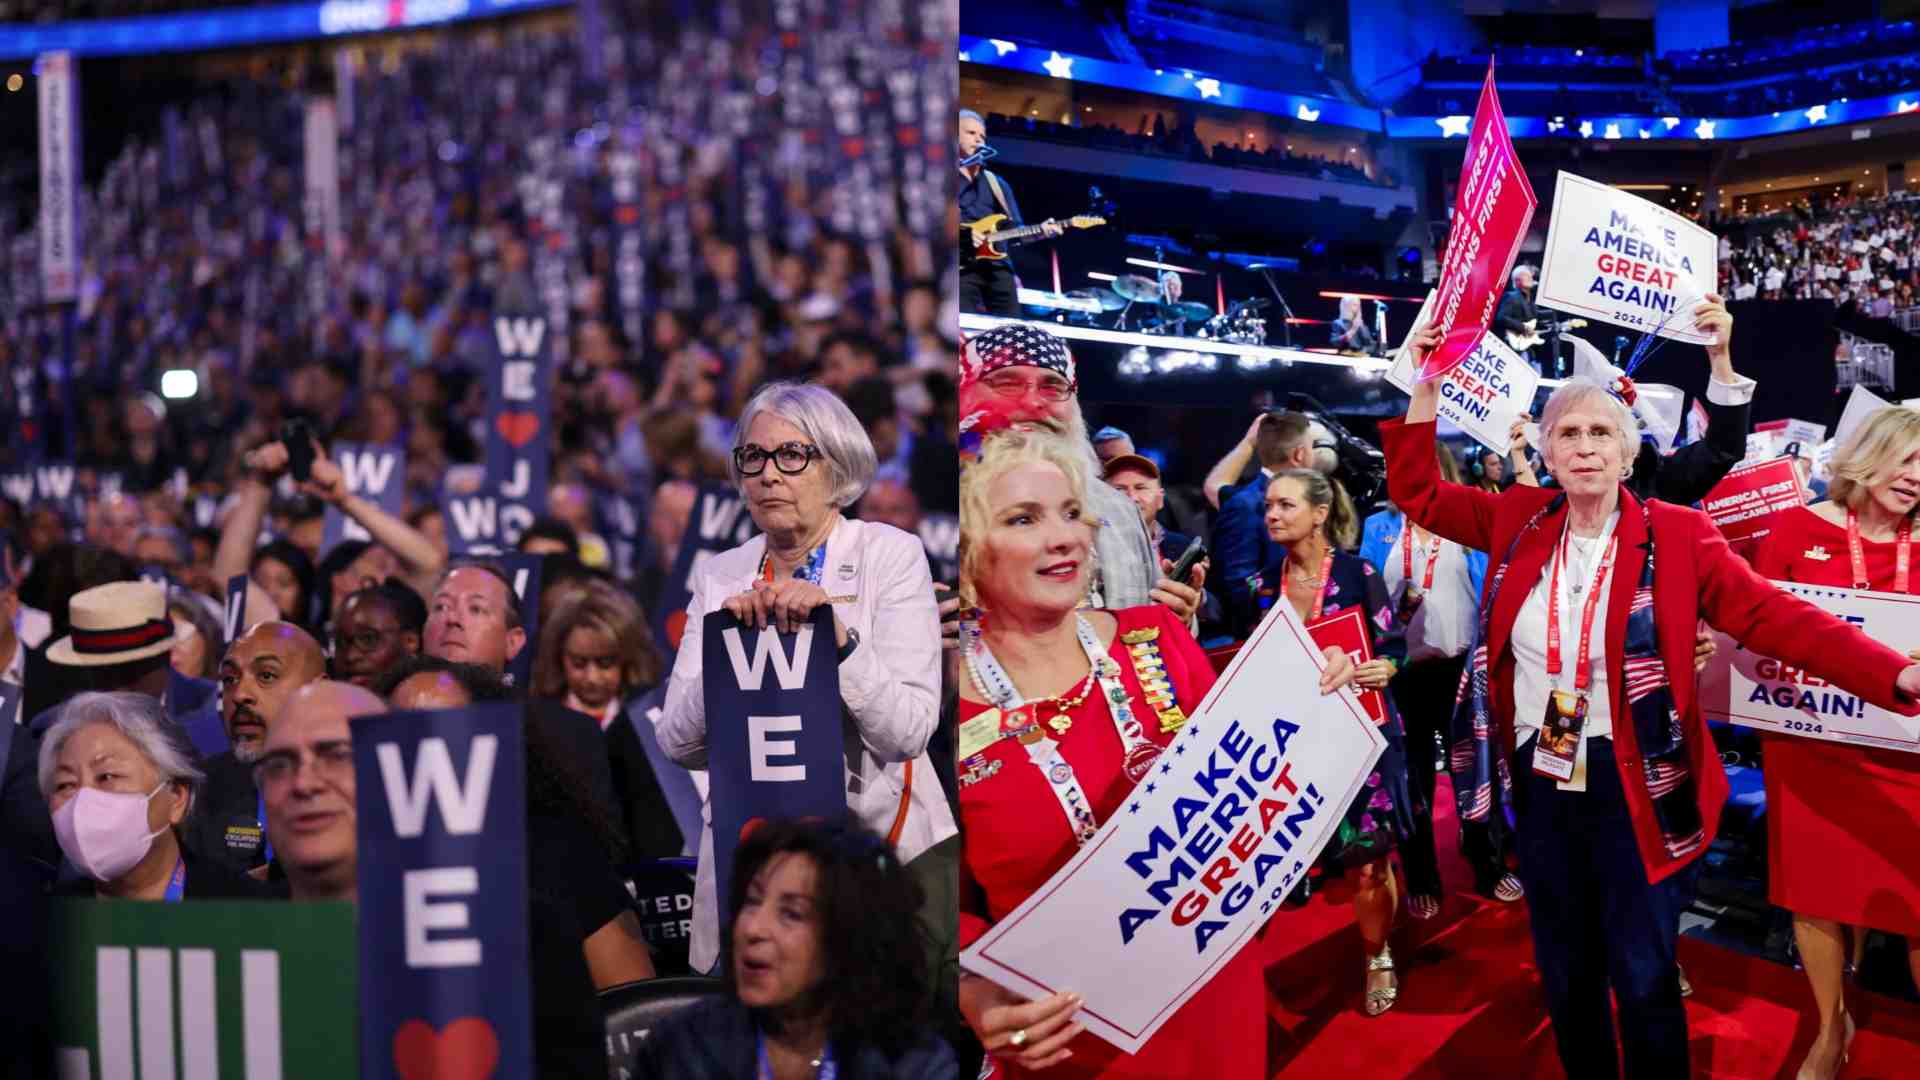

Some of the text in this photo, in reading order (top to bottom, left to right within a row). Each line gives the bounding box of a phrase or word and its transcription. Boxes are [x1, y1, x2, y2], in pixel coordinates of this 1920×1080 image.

[1464, 120, 1493, 208] FIRST
[1477, 156, 1507, 234] FIRST
[1584, 227, 1693, 274] AMERICA
[1597, 254, 1679, 290] GREAT
[1589, 276, 1677, 314] AGAIN!
[1614, 312, 1643, 325] 2024
[1462, 356, 1511, 398] ERICA
[1475, 344, 1506, 373] AKE
[1441, 382, 1490, 422] GAIN!
[1450, 367, 1497, 403] REAT
[1707, 480, 1794, 511] AMERICA FIRST
[721, 623, 814, 782] WE
[1748, 683, 1865, 719] AGAIN!
[1784, 720, 1823, 733] 2024
[1124, 719, 1255, 879] MAKE
[376, 735, 498, 968] WE
[1118, 718, 1301, 944] AMERICA
[1171, 763, 1299, 927] GREAT
[1191, 783, 1325, 954] AGAIN!
[1260, 860, 1304, 914] 2024
